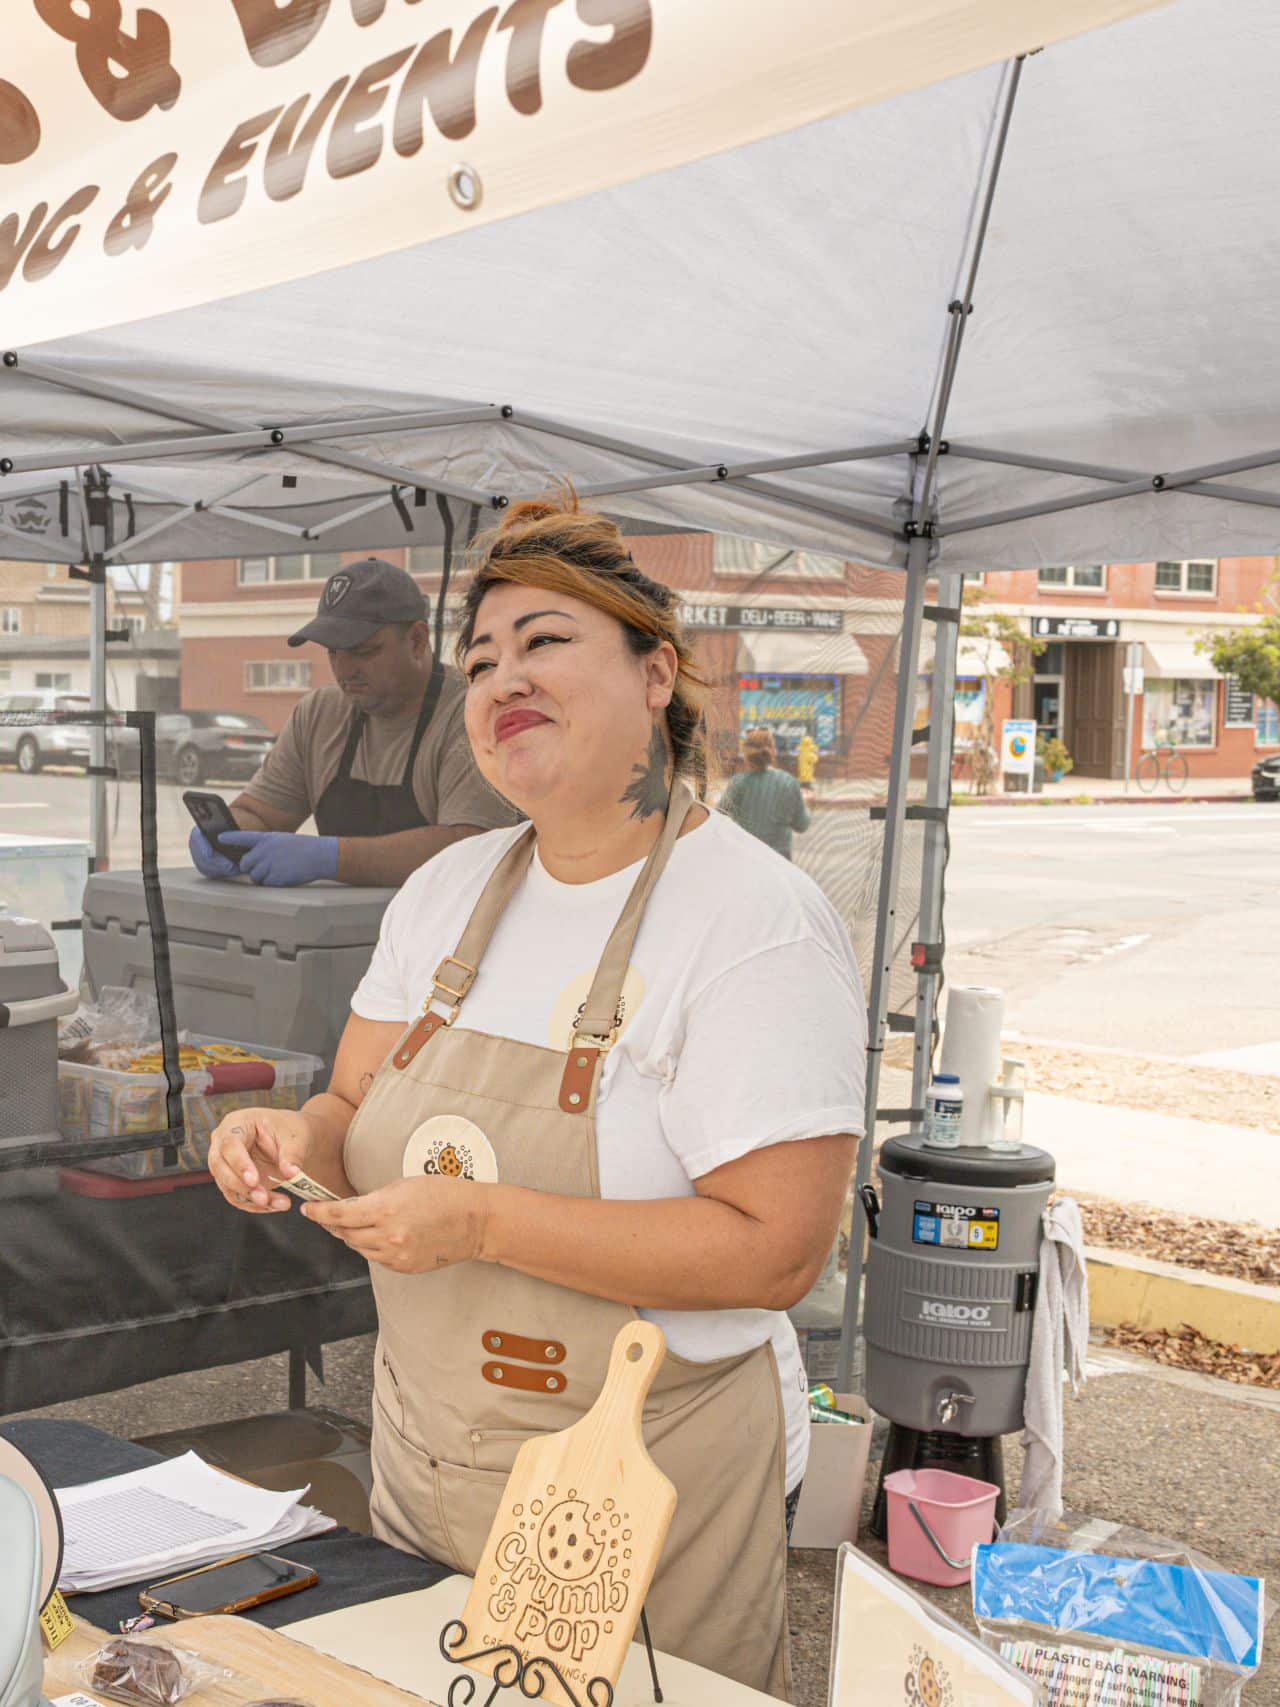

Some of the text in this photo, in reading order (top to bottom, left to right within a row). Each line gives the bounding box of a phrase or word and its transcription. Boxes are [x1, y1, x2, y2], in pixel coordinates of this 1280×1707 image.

[33, 0, 182, 122] &
[103, 151, 178, 256] &
[197, 0, 653, 224] EVENTS
[675, 605, 728, 625] ARKET
[495, 1531, 628, 1614] Crumb
[488, 1583, 516, 1622] &
[1027, 1666, 1054, 1678] avoid
[1057, 1670, 1093, 1685] danger
[1095, 1678, 1105, 1687] of
[1035, 1649, 1189, 1690] PLASTIC BAG WARNING:
